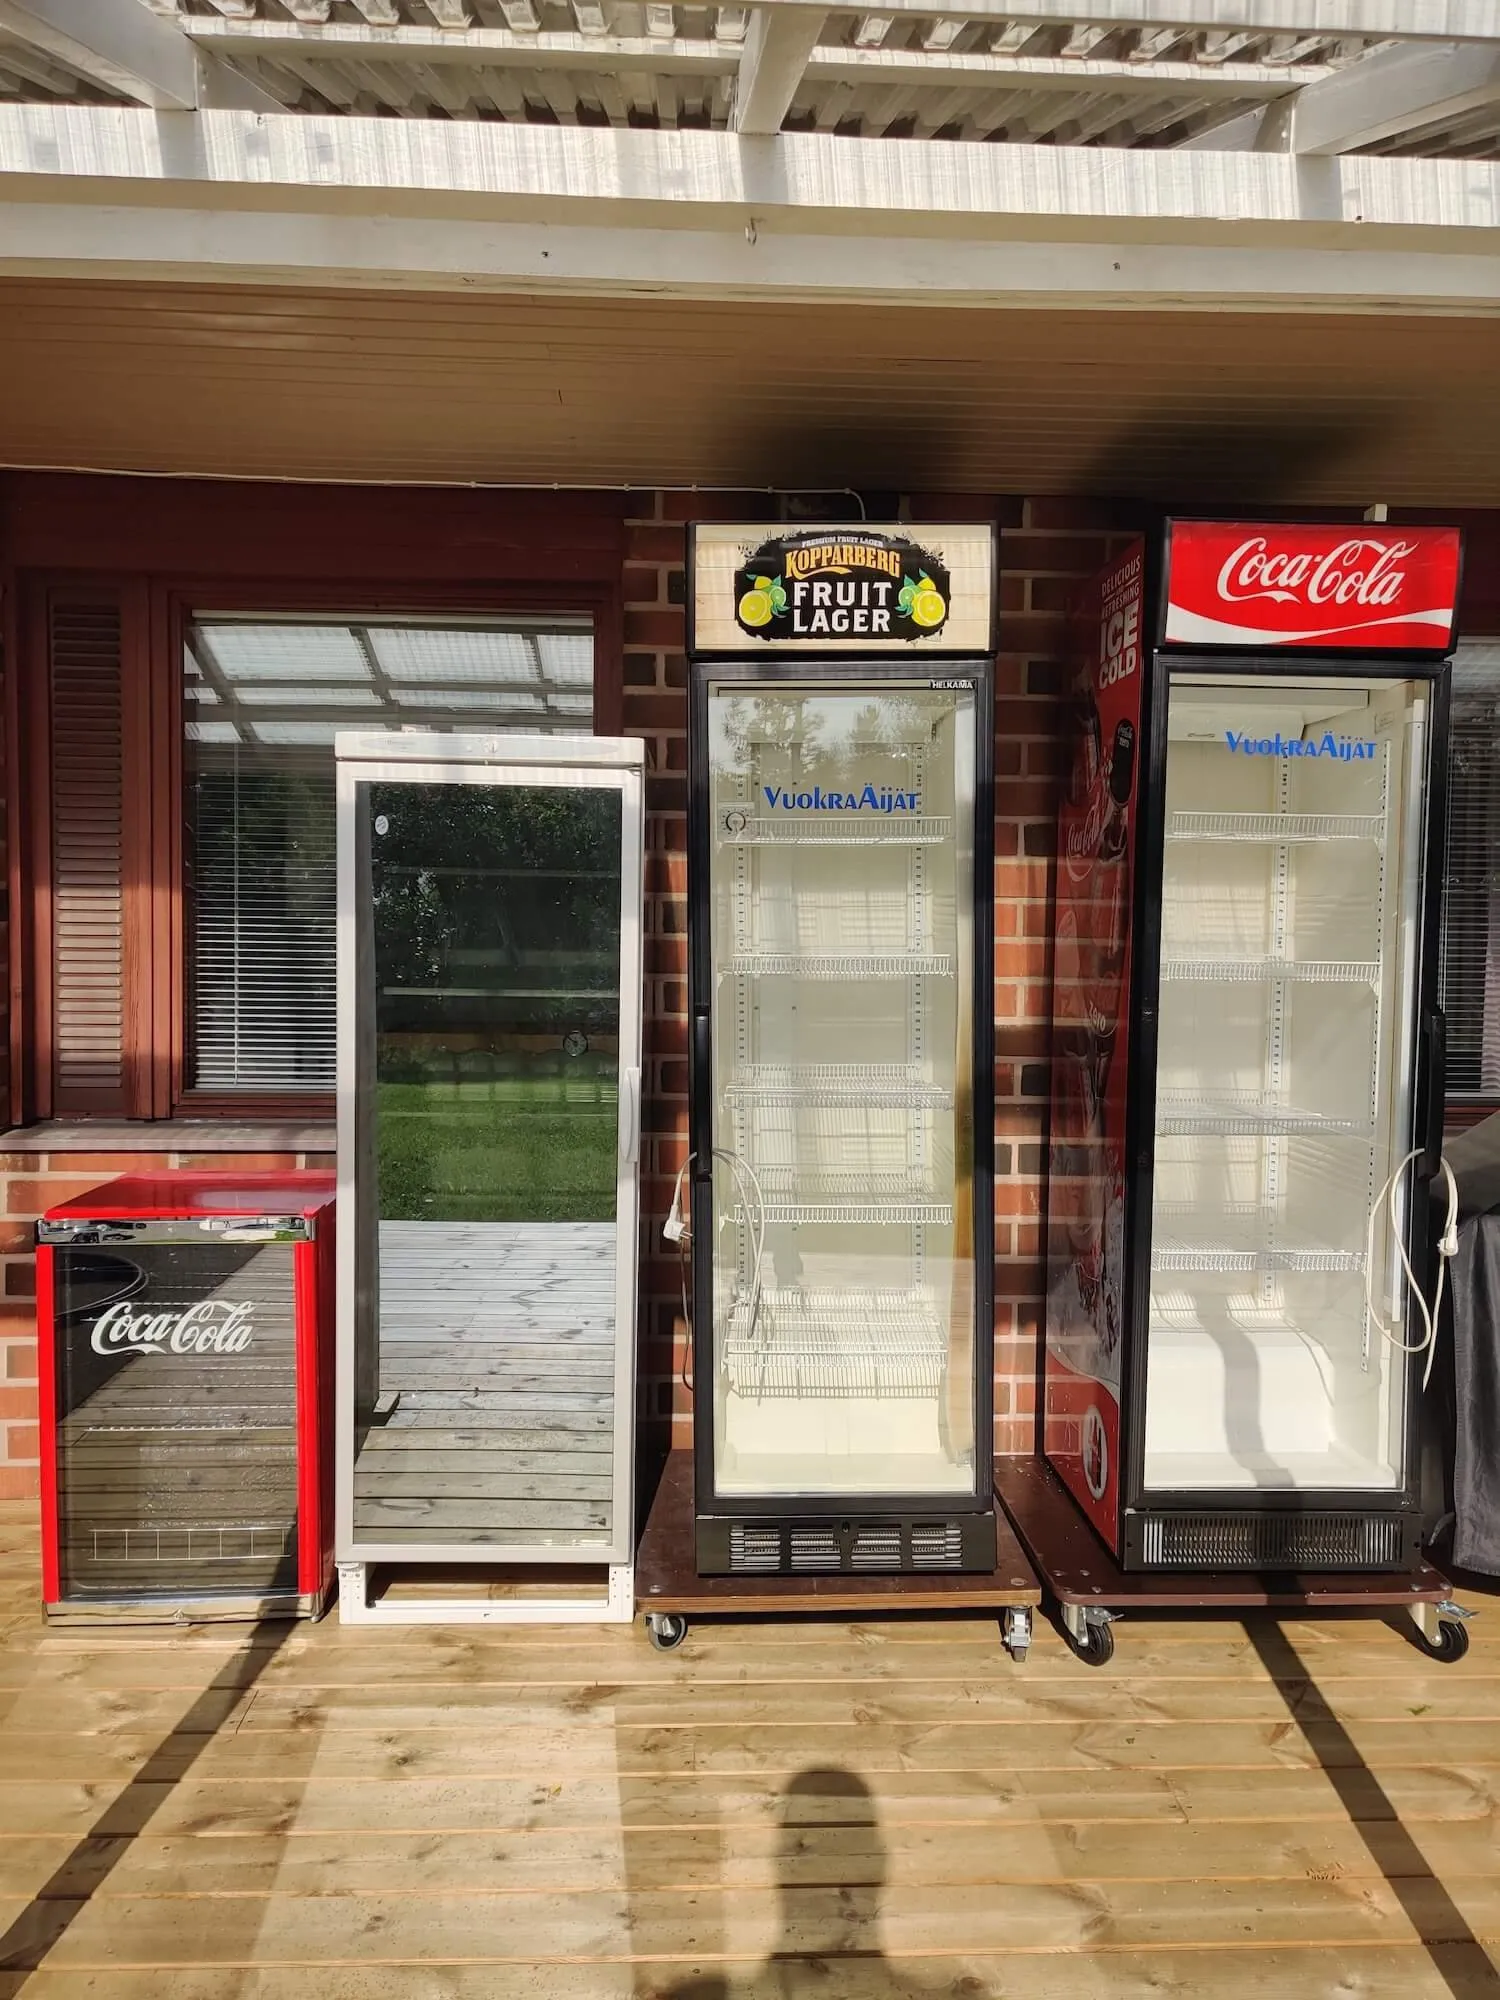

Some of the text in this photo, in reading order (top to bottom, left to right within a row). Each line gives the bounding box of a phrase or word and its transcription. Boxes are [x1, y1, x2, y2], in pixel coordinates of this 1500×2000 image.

[785, 543, 900, 580] KOPPARBERG
[837, 535, 859, 543] FRUIT
[860, 537, 884, 548] LAGER
[1101, 555, 1141, 598] DELICIOUS
[1217, 537, 1419, 605] Coca-Cola
[793, 581, 892, 607] FRUIT
[793, 609, 891, 633] LAGER
[1100, 599, 1139, 665] ICE
[932, 679, 974, 689] HELKAMA
[1099, 647, 1136, 690] COLD
[91, 1300, 256, 1355] Coca-Cola
